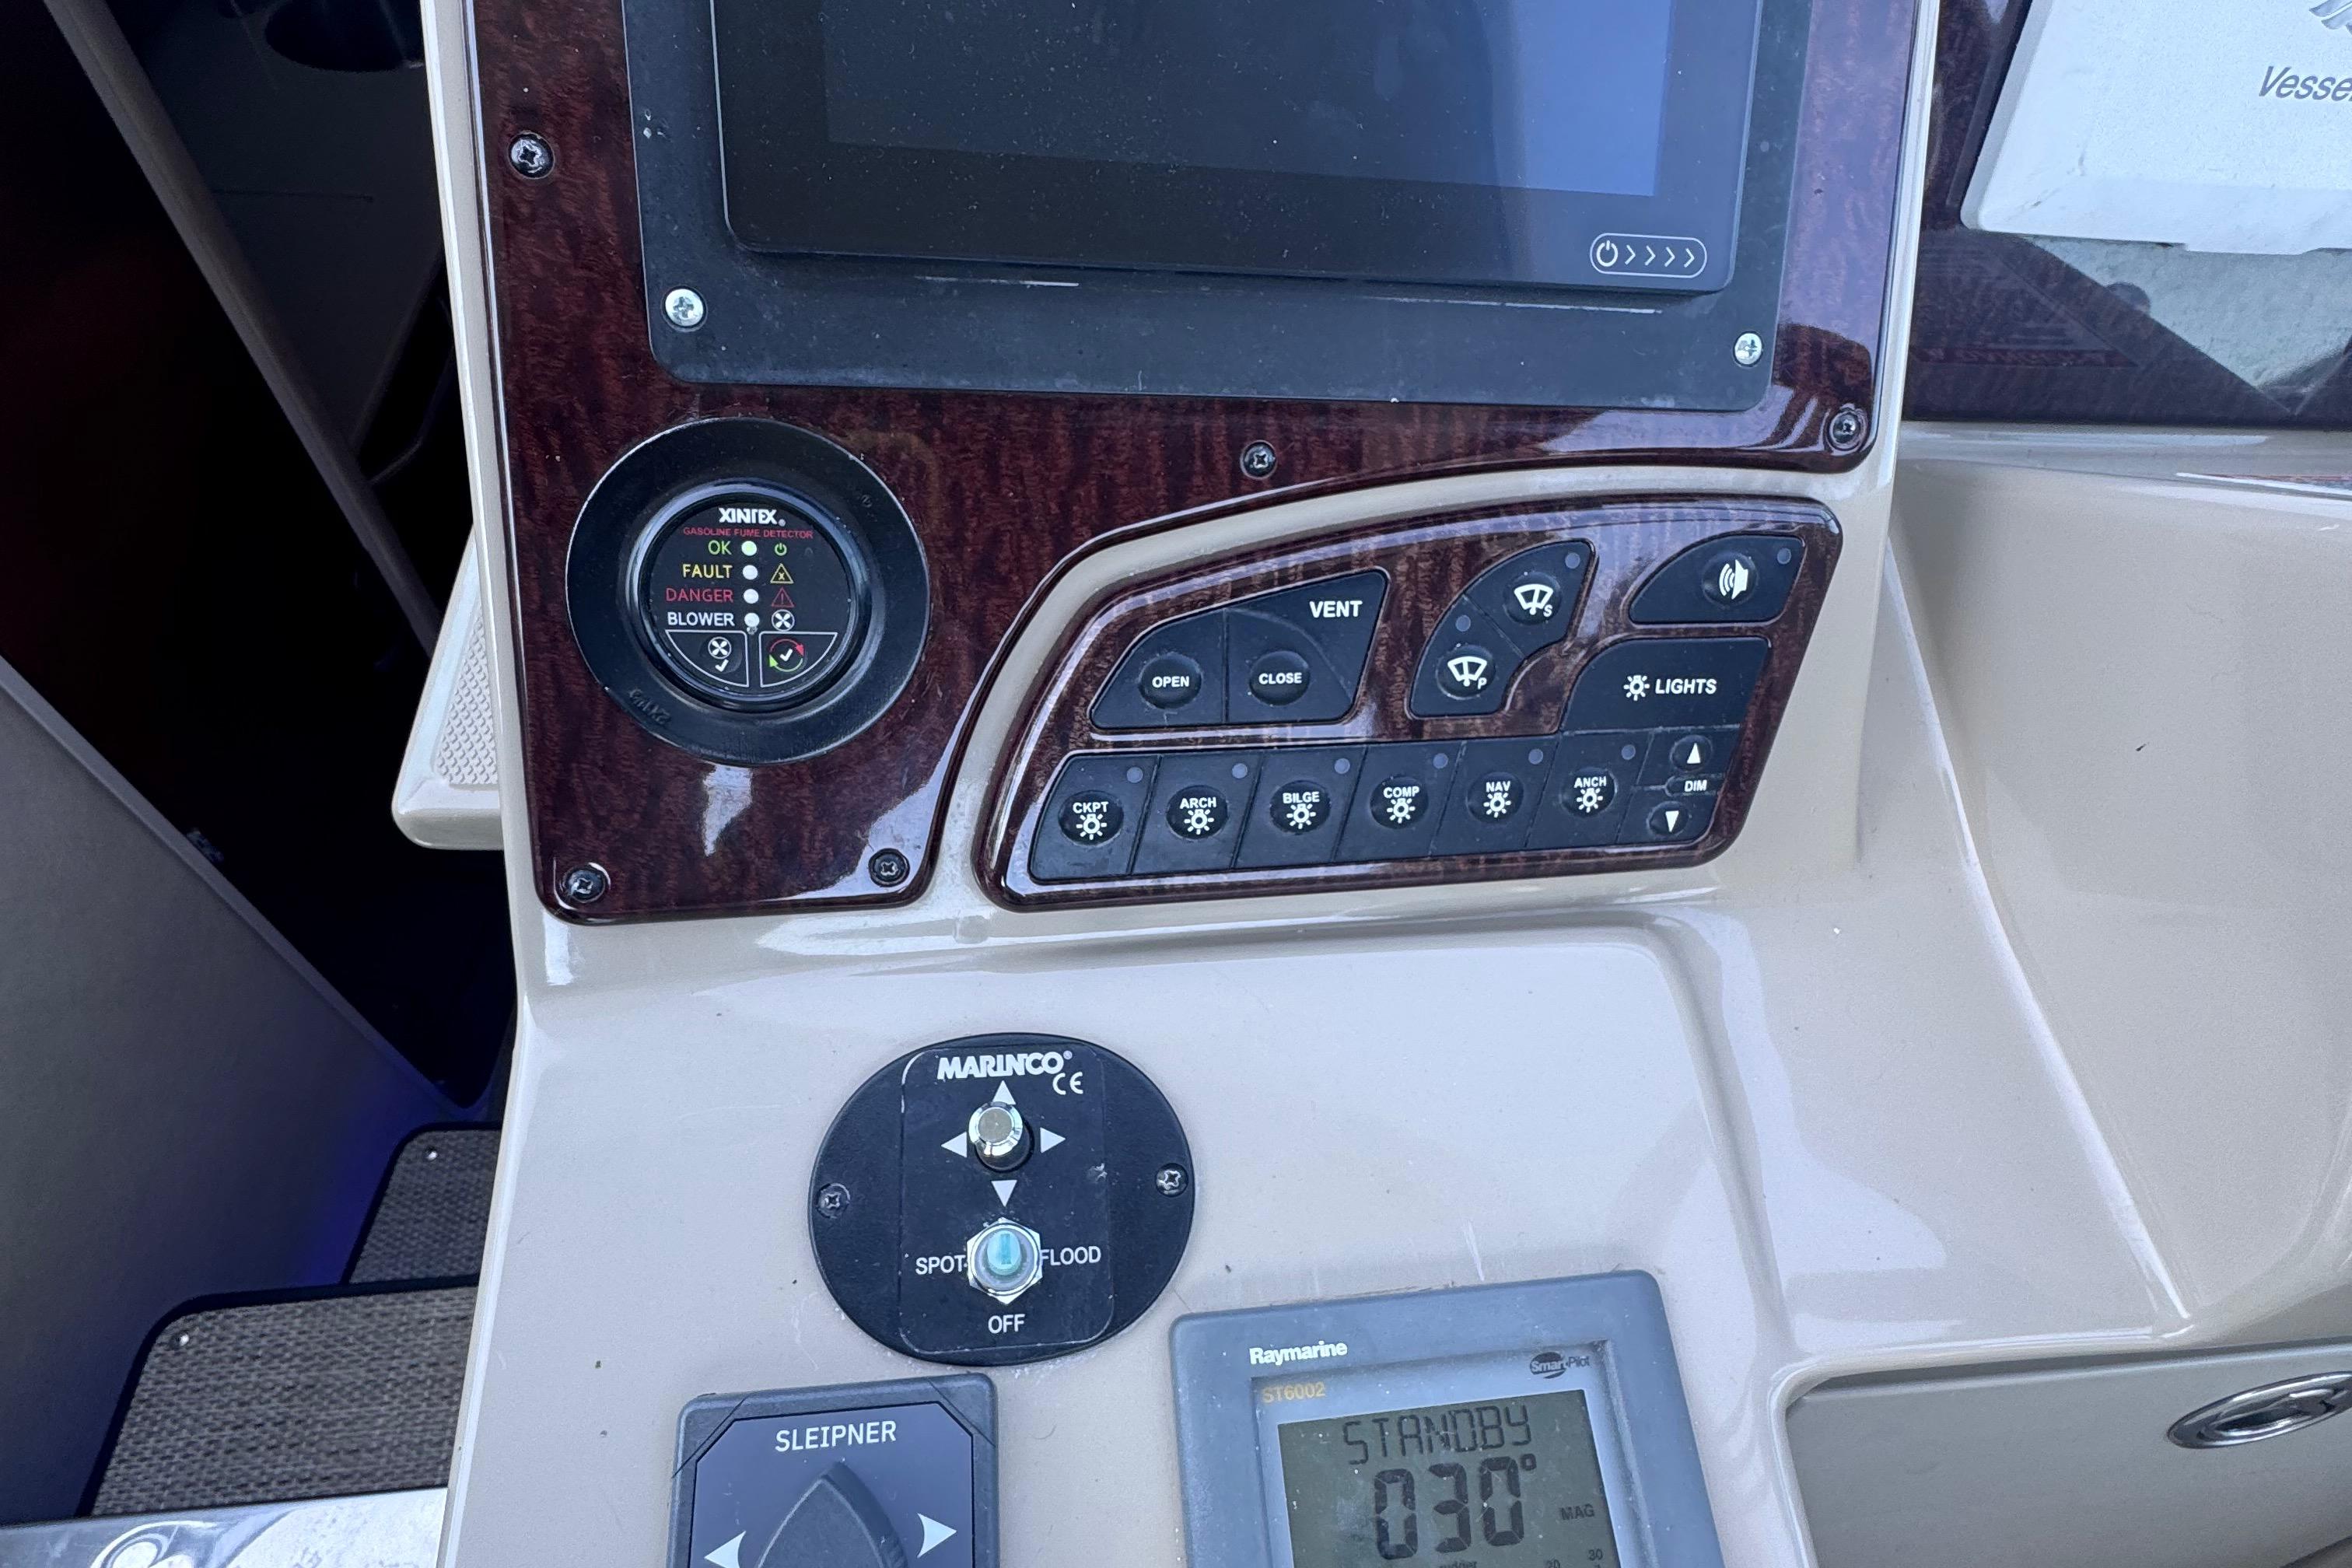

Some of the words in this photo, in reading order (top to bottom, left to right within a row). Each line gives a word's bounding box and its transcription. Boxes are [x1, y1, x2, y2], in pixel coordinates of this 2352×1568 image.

[2259, 65, 2352, 101] Vesse
[719, 508, 778, 524] XINTEX
[684, 527, 731, 537] GASOLINE
[763, 530, 814, 539] DETECTOR
[708, 540, 732, 555] OK
[682, 563, 733, 579] FAULT
[665, 587, 734, 603] DANGER
[1310, 600, 1363, 618] VENT
[1543, 604, 1553, 618] S
[667, 611, 735, 627] BLOWER
[1151, 675, 1190, 689] OPEN
[1258, 671, 1303, 685] CLOSE
[1477, 677, 1487, 690] P
[1655, 679, 1717, 695] LIGHTS
[1486, 781, 1511, 792] NAV
[1573, 776, 1607, 788] ANCH
[1685, 780, 1707, 792] DIM
[1282, 791, 1320, 804] BILGE
[1383, 786, 1419, 799] COMP
[1073, 801, 1109, 815] CKPT
[1180, 796, 1217, 810] ARCH
[1041, 1245, 1101, 1266] FLOOD
[915, 1255, 966, 1275] SPOT
[988, 1314, 1025, 1334] OFF
[1250, 1340, 1348, 1367] Raymarine
[1262, 1381, 1326, 1402] ST6002
[775, 1420, 897, 1452] SLEIPNER
[1342, 1405, 1531, 1465] STANDBY
[1560, 1503, 1595, 1521] MAG
[1588, 1548, 1604, 1561] 30
